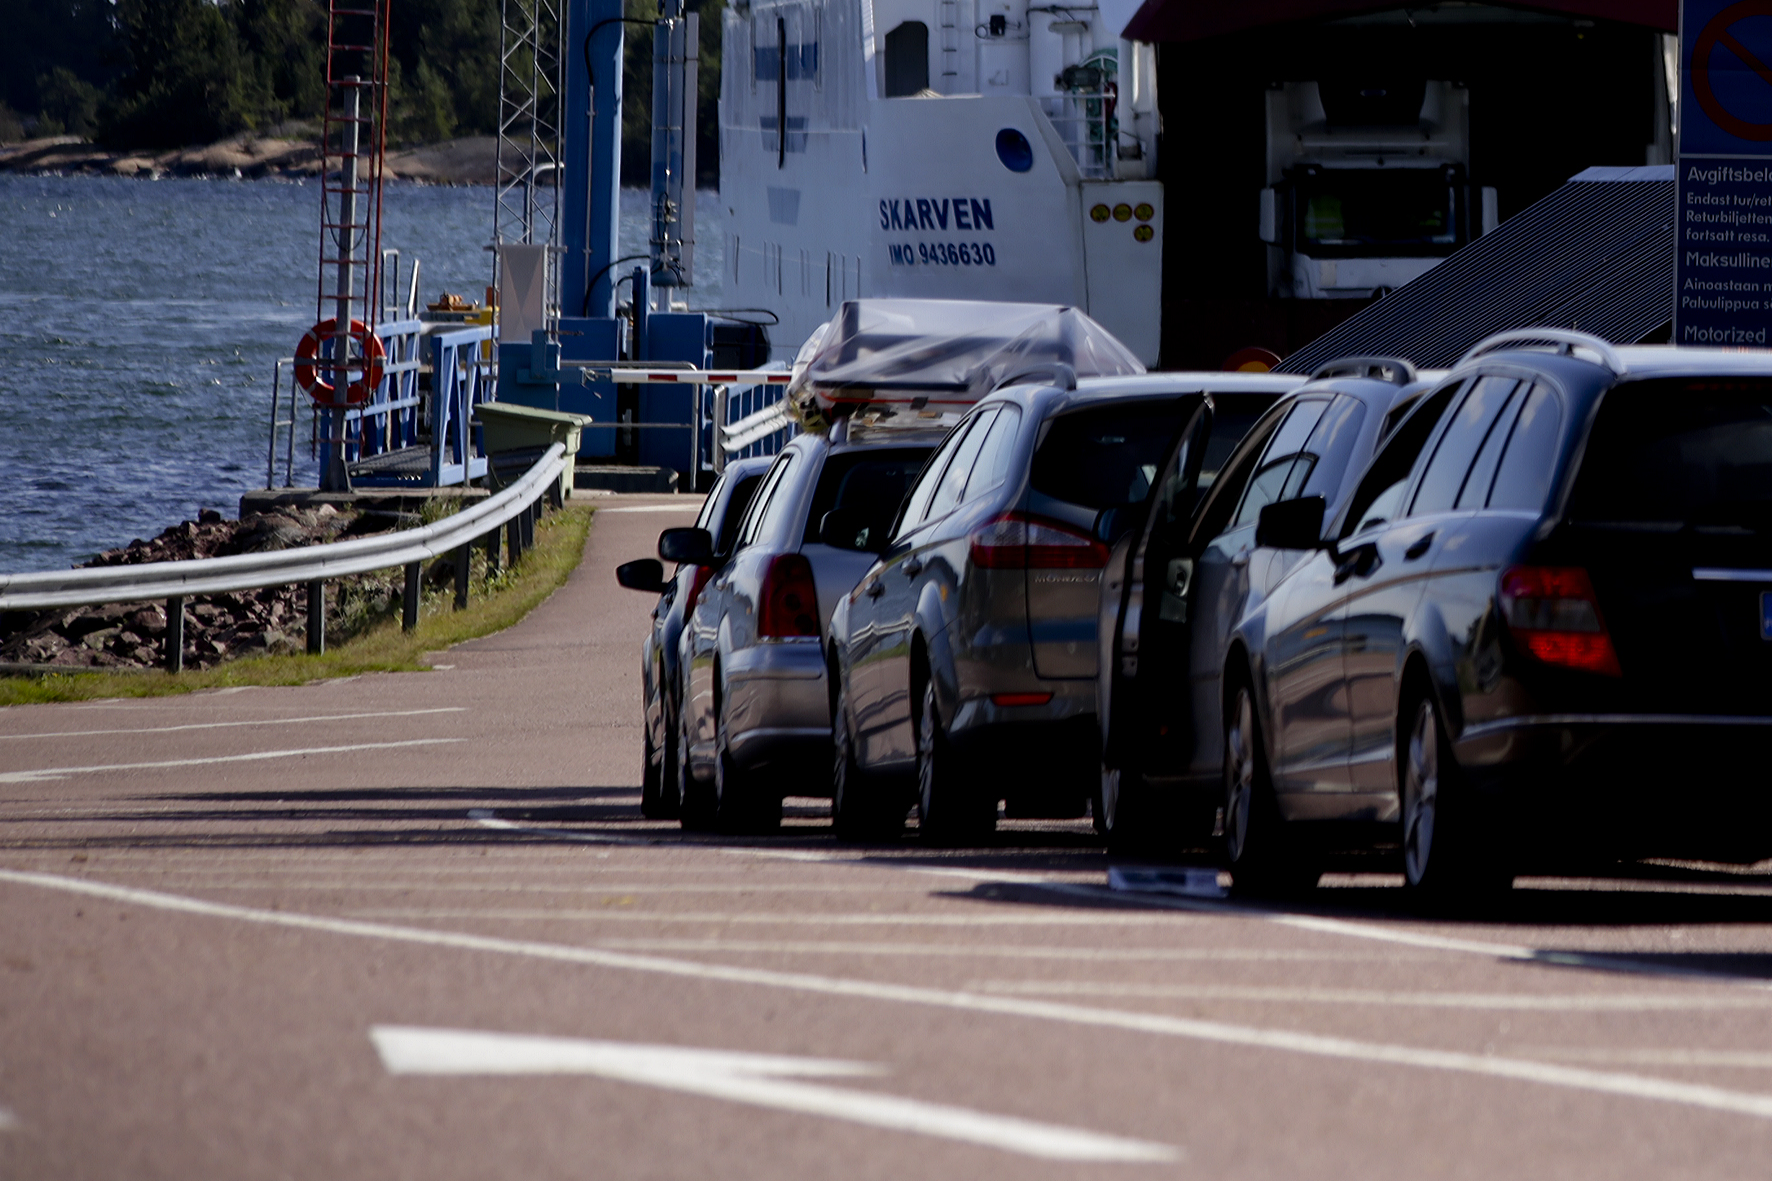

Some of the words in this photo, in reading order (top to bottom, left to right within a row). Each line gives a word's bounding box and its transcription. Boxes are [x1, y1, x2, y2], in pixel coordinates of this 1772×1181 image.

[1686, 192, 1730, 206] Endast
[879, 198, 994, 231] SKARVEN
[1686, 209, 1772, 227] Returbiljetten
[1686, 227, 1735, 241] fortsatt
[1738, 232, 1770, 243] resa.
[888, 244, 915, 265] IMO
[918, 242, 996, 266] 9436630
[1684, 277, 1760, 292] Ainoastaan
[1682, 296, 1760, 312] Paluulippua
[1685, 325, 1766, 344] Motorized
